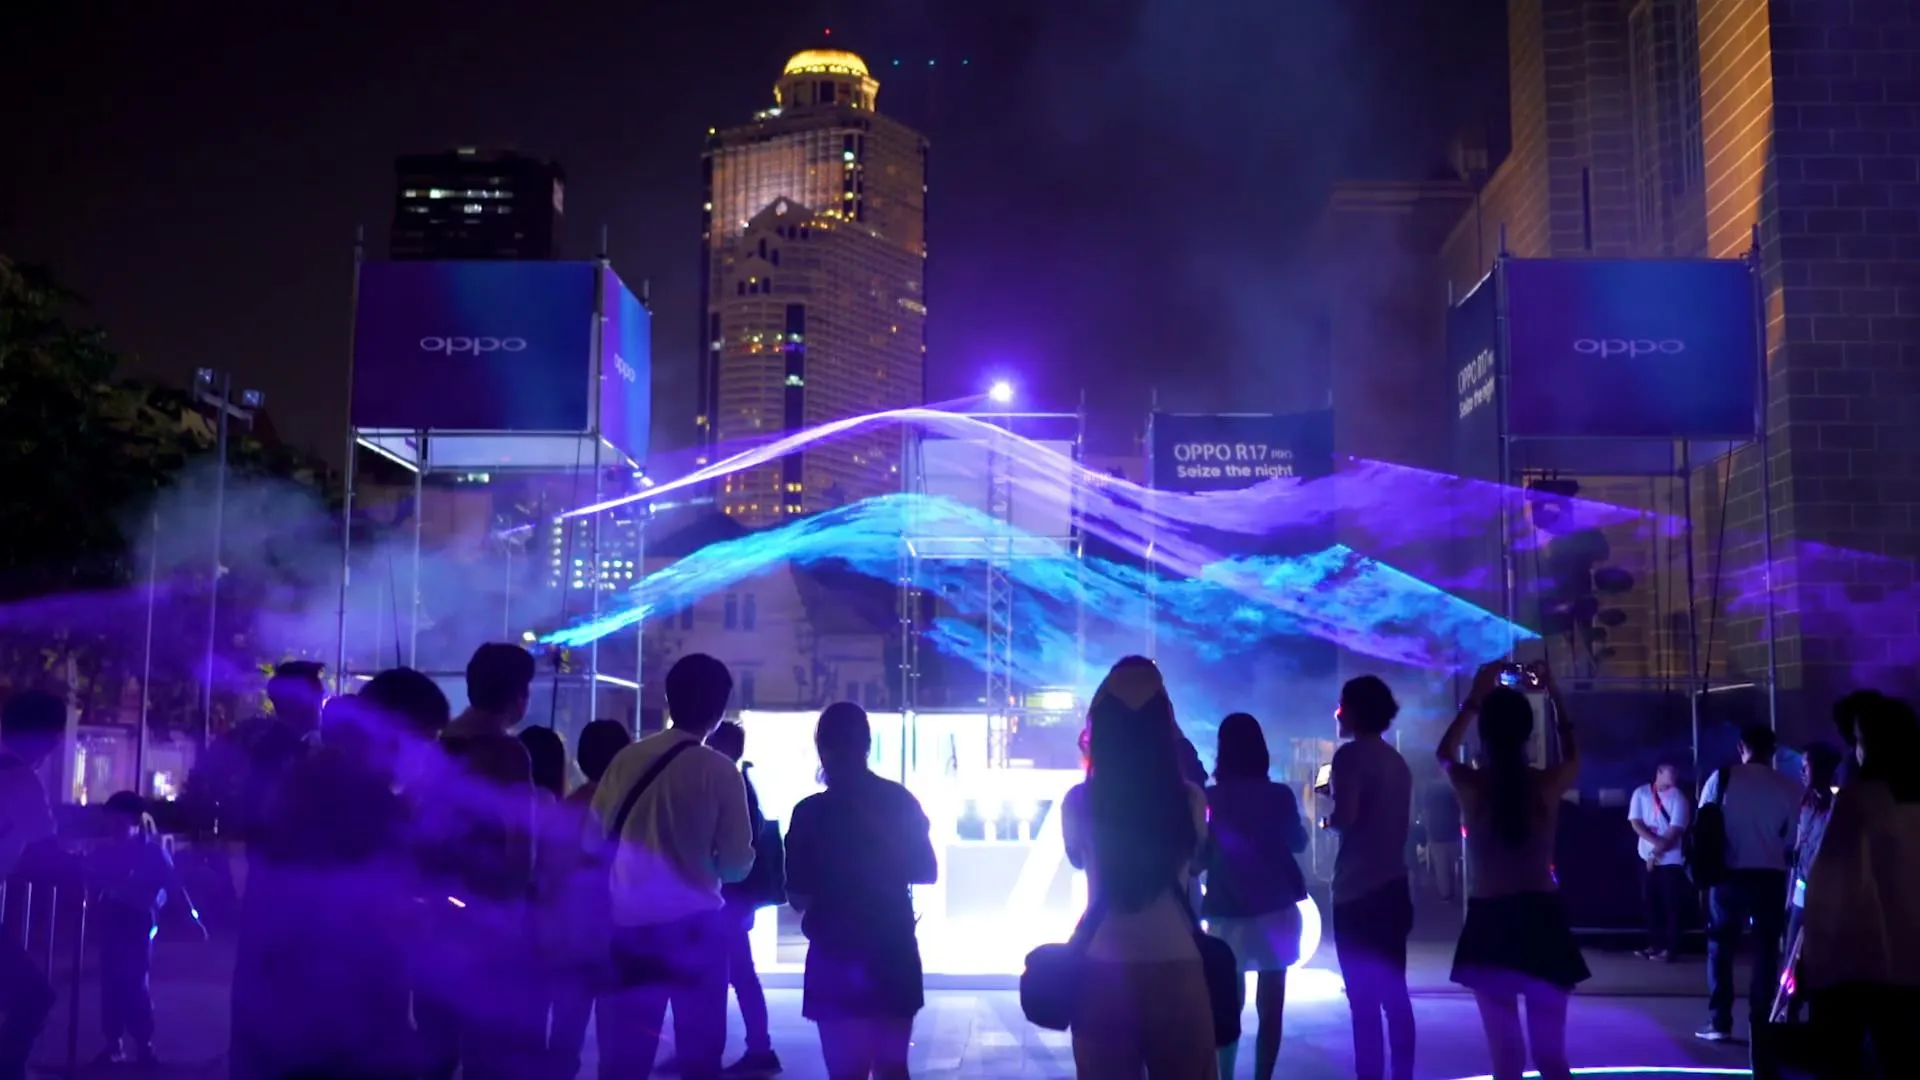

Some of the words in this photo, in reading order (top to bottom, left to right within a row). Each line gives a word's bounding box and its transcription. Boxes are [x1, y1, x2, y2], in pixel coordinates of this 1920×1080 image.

[420, 336, 526, 355] oppo
[1573, 339, 1685, 358] oppo
[614, 352, 636, 382] oppo
[1173, 443, 1231, 462] OPPO
[1235, 443, 1268, 460] R17
[1176, 463, 1222, 478] Seize
[1225, 463, 1252, 477] the
[1255, 463, 1294, 480] night
